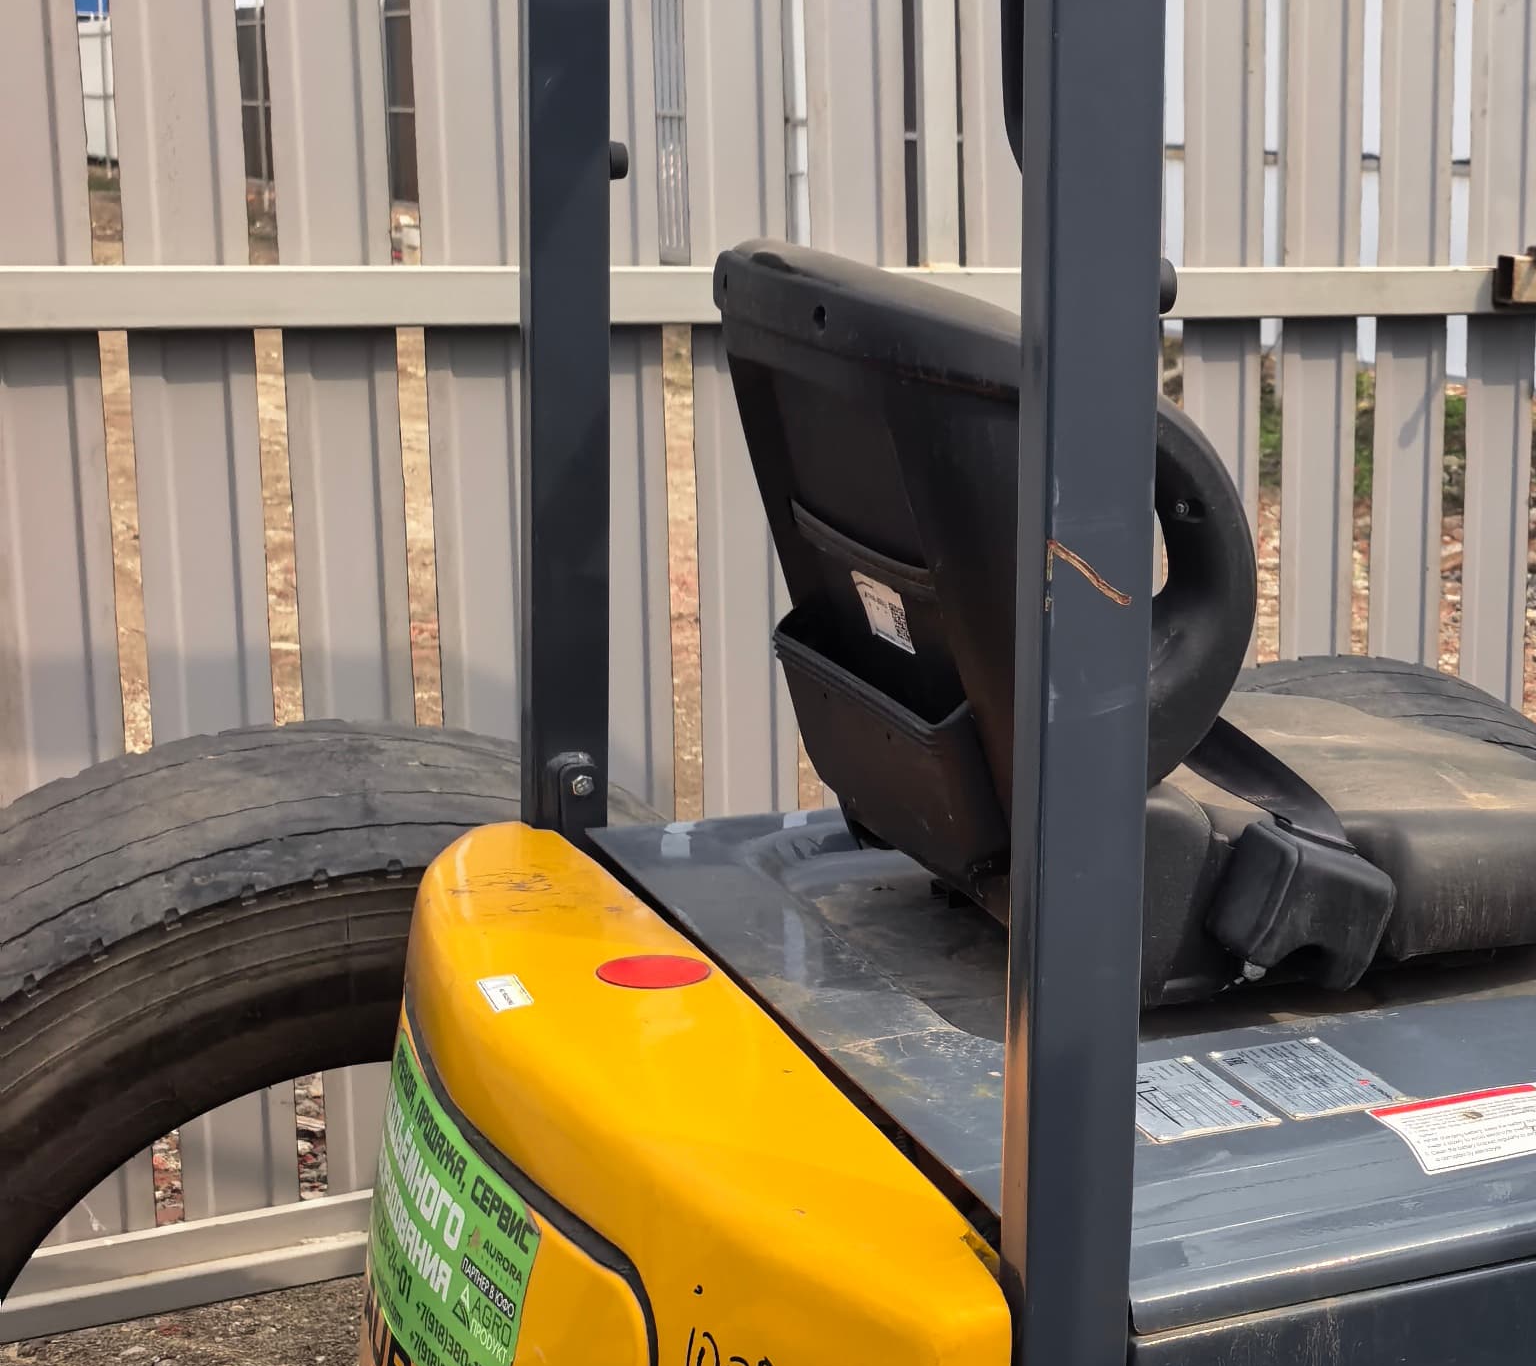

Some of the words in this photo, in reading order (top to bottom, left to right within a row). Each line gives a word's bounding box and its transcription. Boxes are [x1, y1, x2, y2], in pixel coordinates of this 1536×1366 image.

[414, 1096, 468, 1194] ПРОДАЖА,
[470, 1174, 537, 1256] СЕРВИС
[461, 1256, 490, 1294] ПАРТНЕР
[494, 1289, 516, 1319] ЮФО
[482, 1238, 523, 1286] AURORA
[469, 1318, 509, 1365] ПРОДУКТ
[470, 1296, 513, 1348] AGRO
